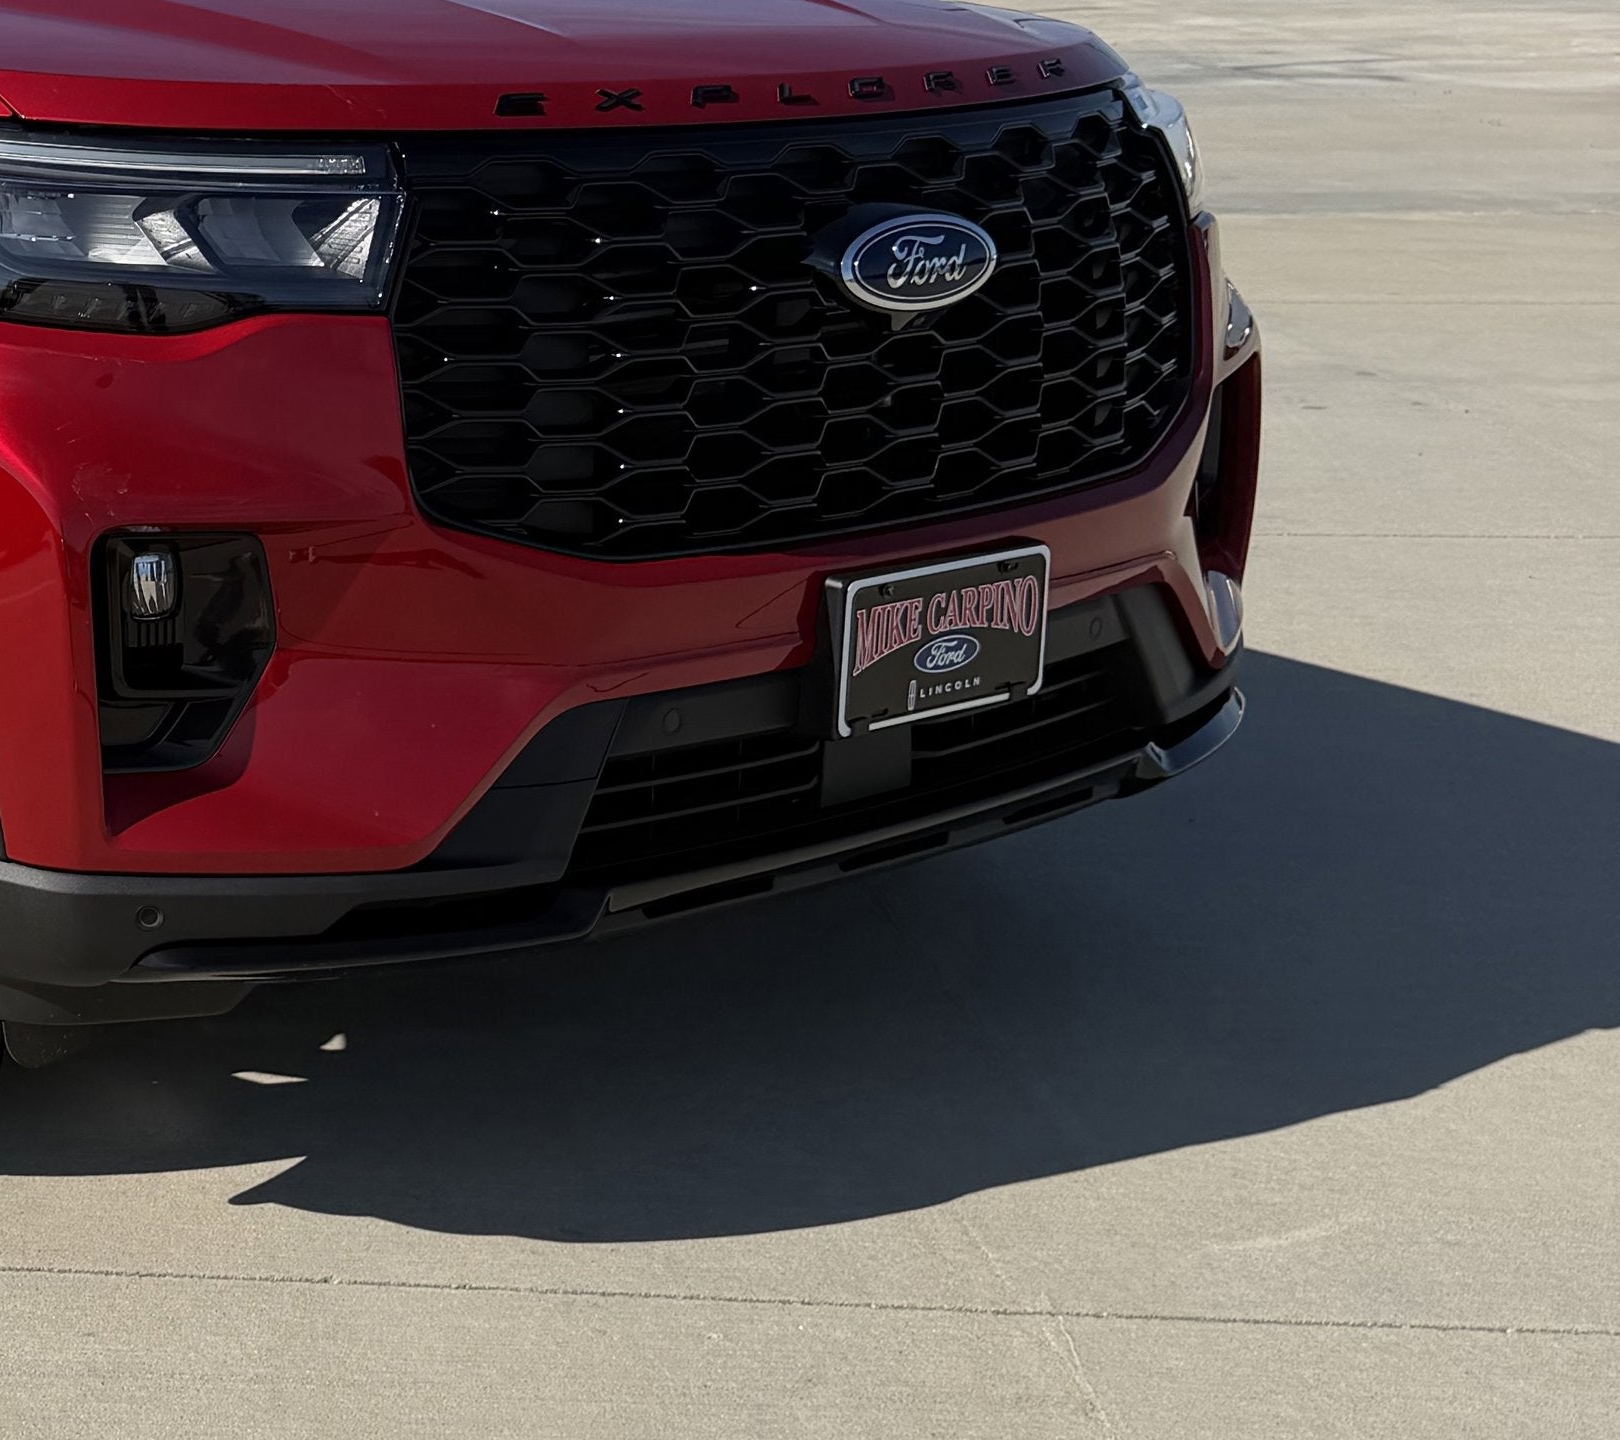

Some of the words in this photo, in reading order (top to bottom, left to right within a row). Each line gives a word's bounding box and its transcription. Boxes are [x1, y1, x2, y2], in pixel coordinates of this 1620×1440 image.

[494, 58, 1064, 117] EXPLORER
[886, 234, 967, 289] Ford
[852, 597, 924, 677] MIKE
[926, 575, 1039, 637] CARPINO
[926, 640, 967, 669] Ford
[919, 676, 981, 699] LINCOLN
